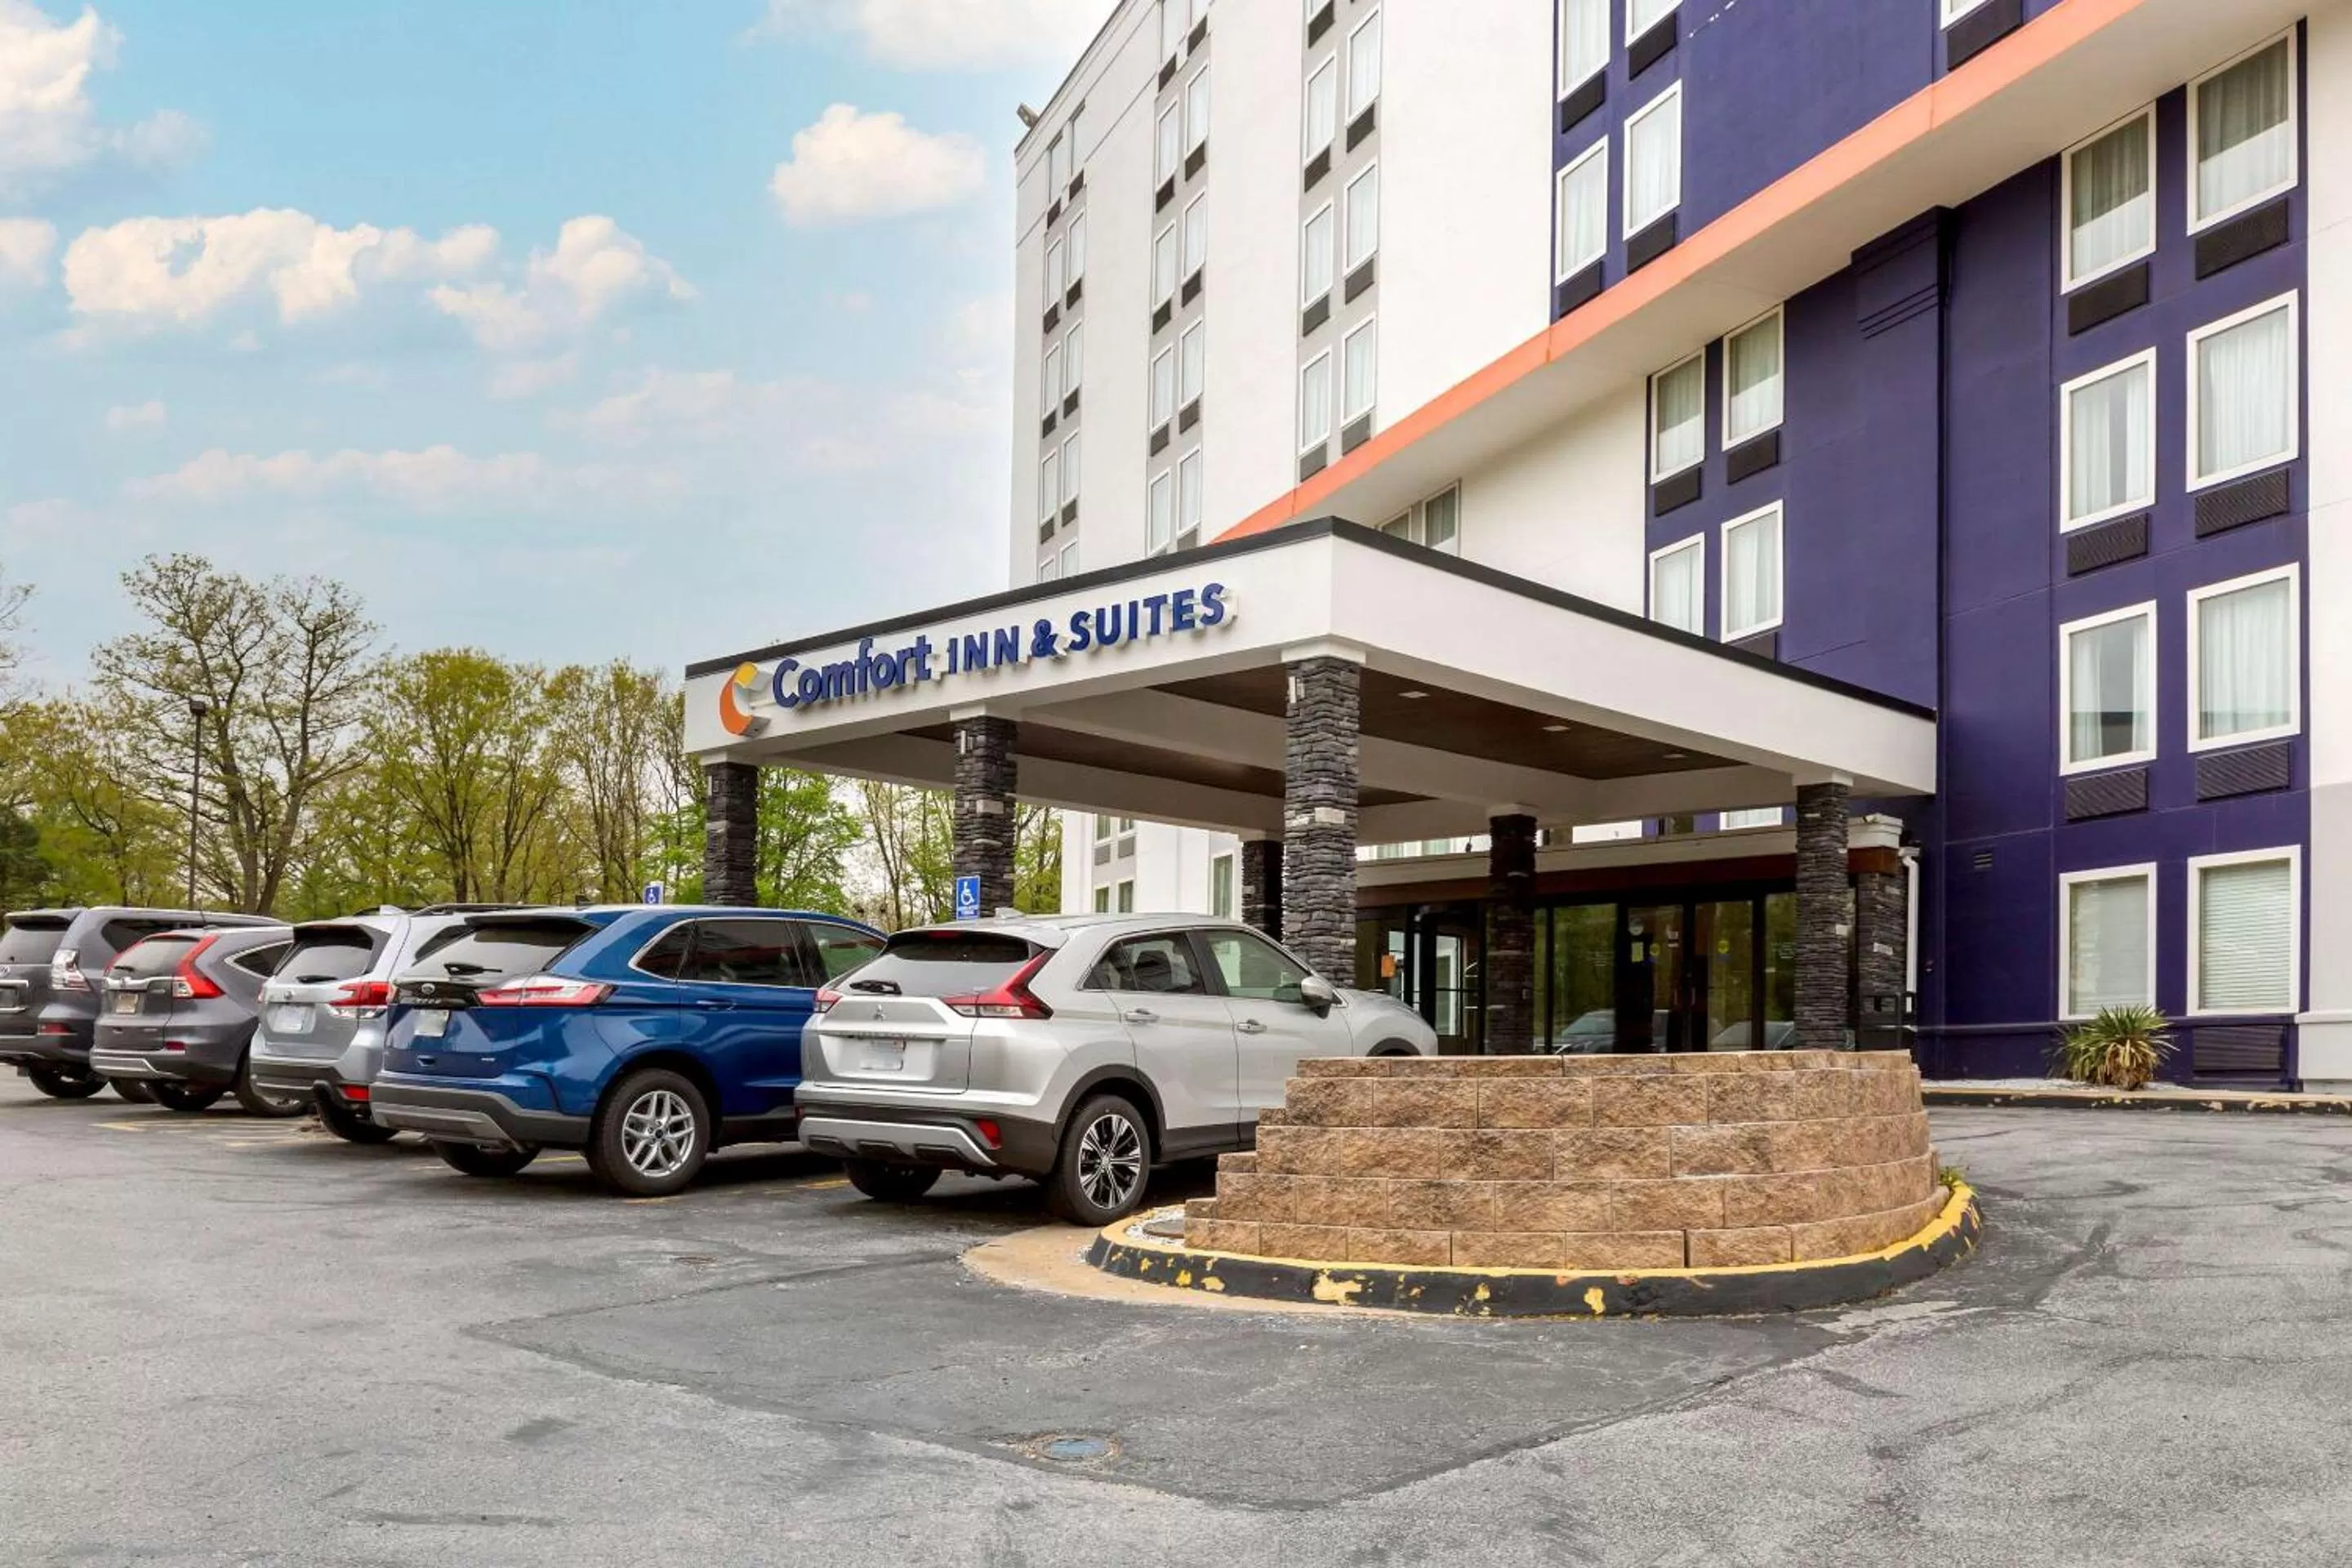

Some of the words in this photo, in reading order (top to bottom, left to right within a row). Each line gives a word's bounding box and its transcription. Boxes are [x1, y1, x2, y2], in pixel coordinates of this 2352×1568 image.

[773, 635, 932, 708] Comfort
[948, 626, 1020, 674] INN
[1031, 619, 1058, 657] &
[1069, 583, 1225, 651] SUITES
